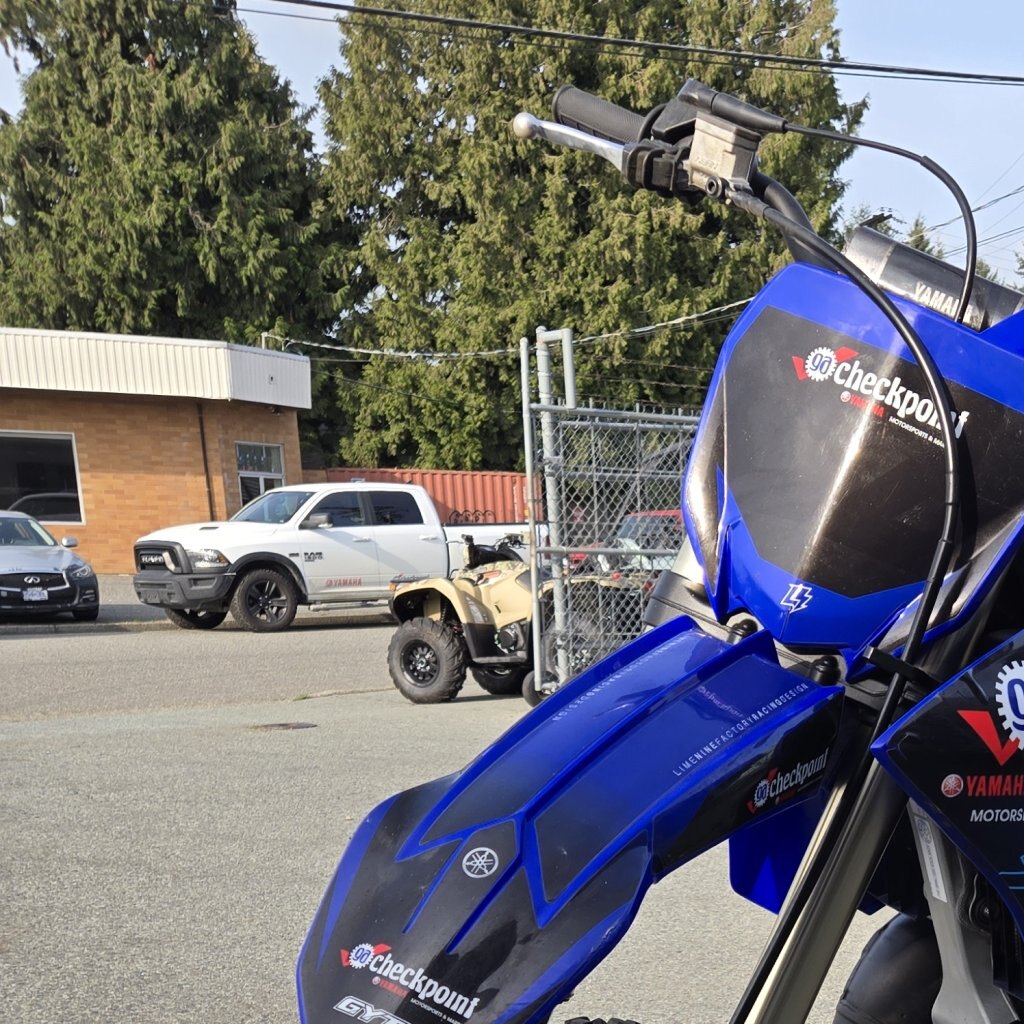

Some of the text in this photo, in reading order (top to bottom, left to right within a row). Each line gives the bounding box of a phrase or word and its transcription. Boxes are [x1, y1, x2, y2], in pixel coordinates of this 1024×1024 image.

[833, 360, 970, 439] checkpoit
[769, 746, 829, 798] checkpoint
[368, 953, 481, 1019] checkpoint
